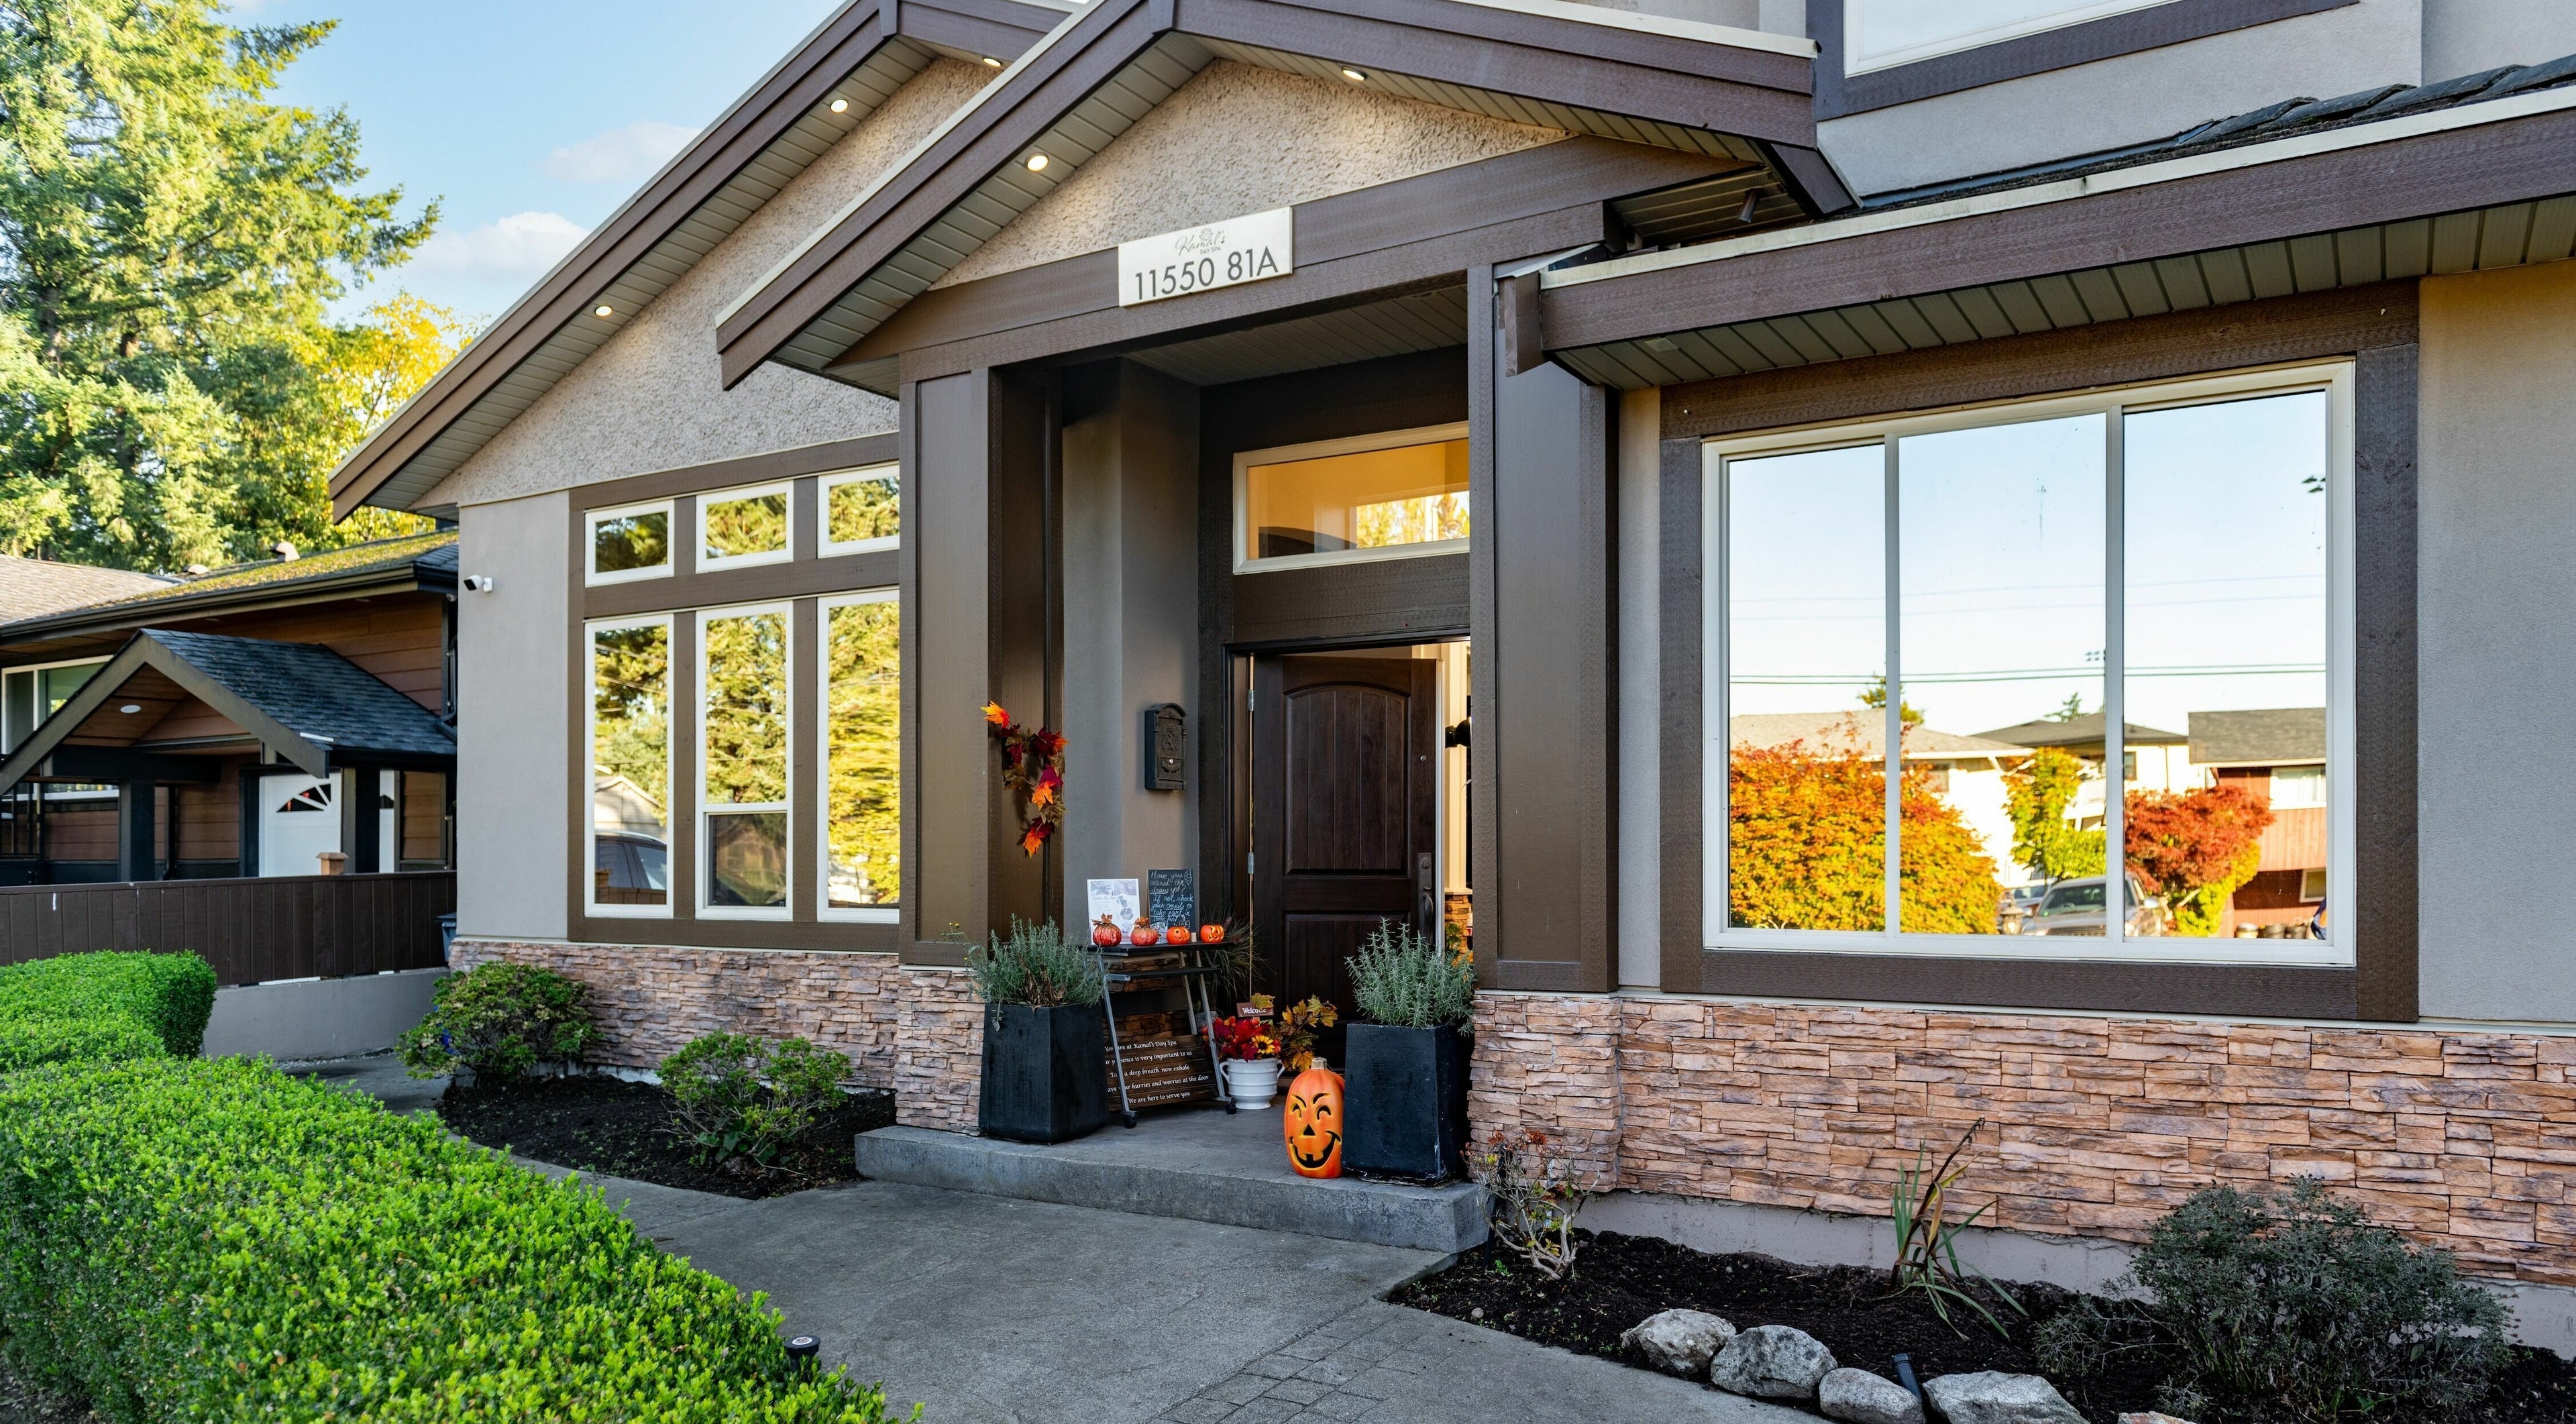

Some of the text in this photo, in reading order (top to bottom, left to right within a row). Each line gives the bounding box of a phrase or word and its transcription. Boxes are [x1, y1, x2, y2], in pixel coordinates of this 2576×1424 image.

[1175, 230, 1225, 256] Kamal's
[1135, 245, 1279, 300] 11550 81A
[1151, 871, 1183, 883] Have you
[1154, 1052, 1179, 1060] important
